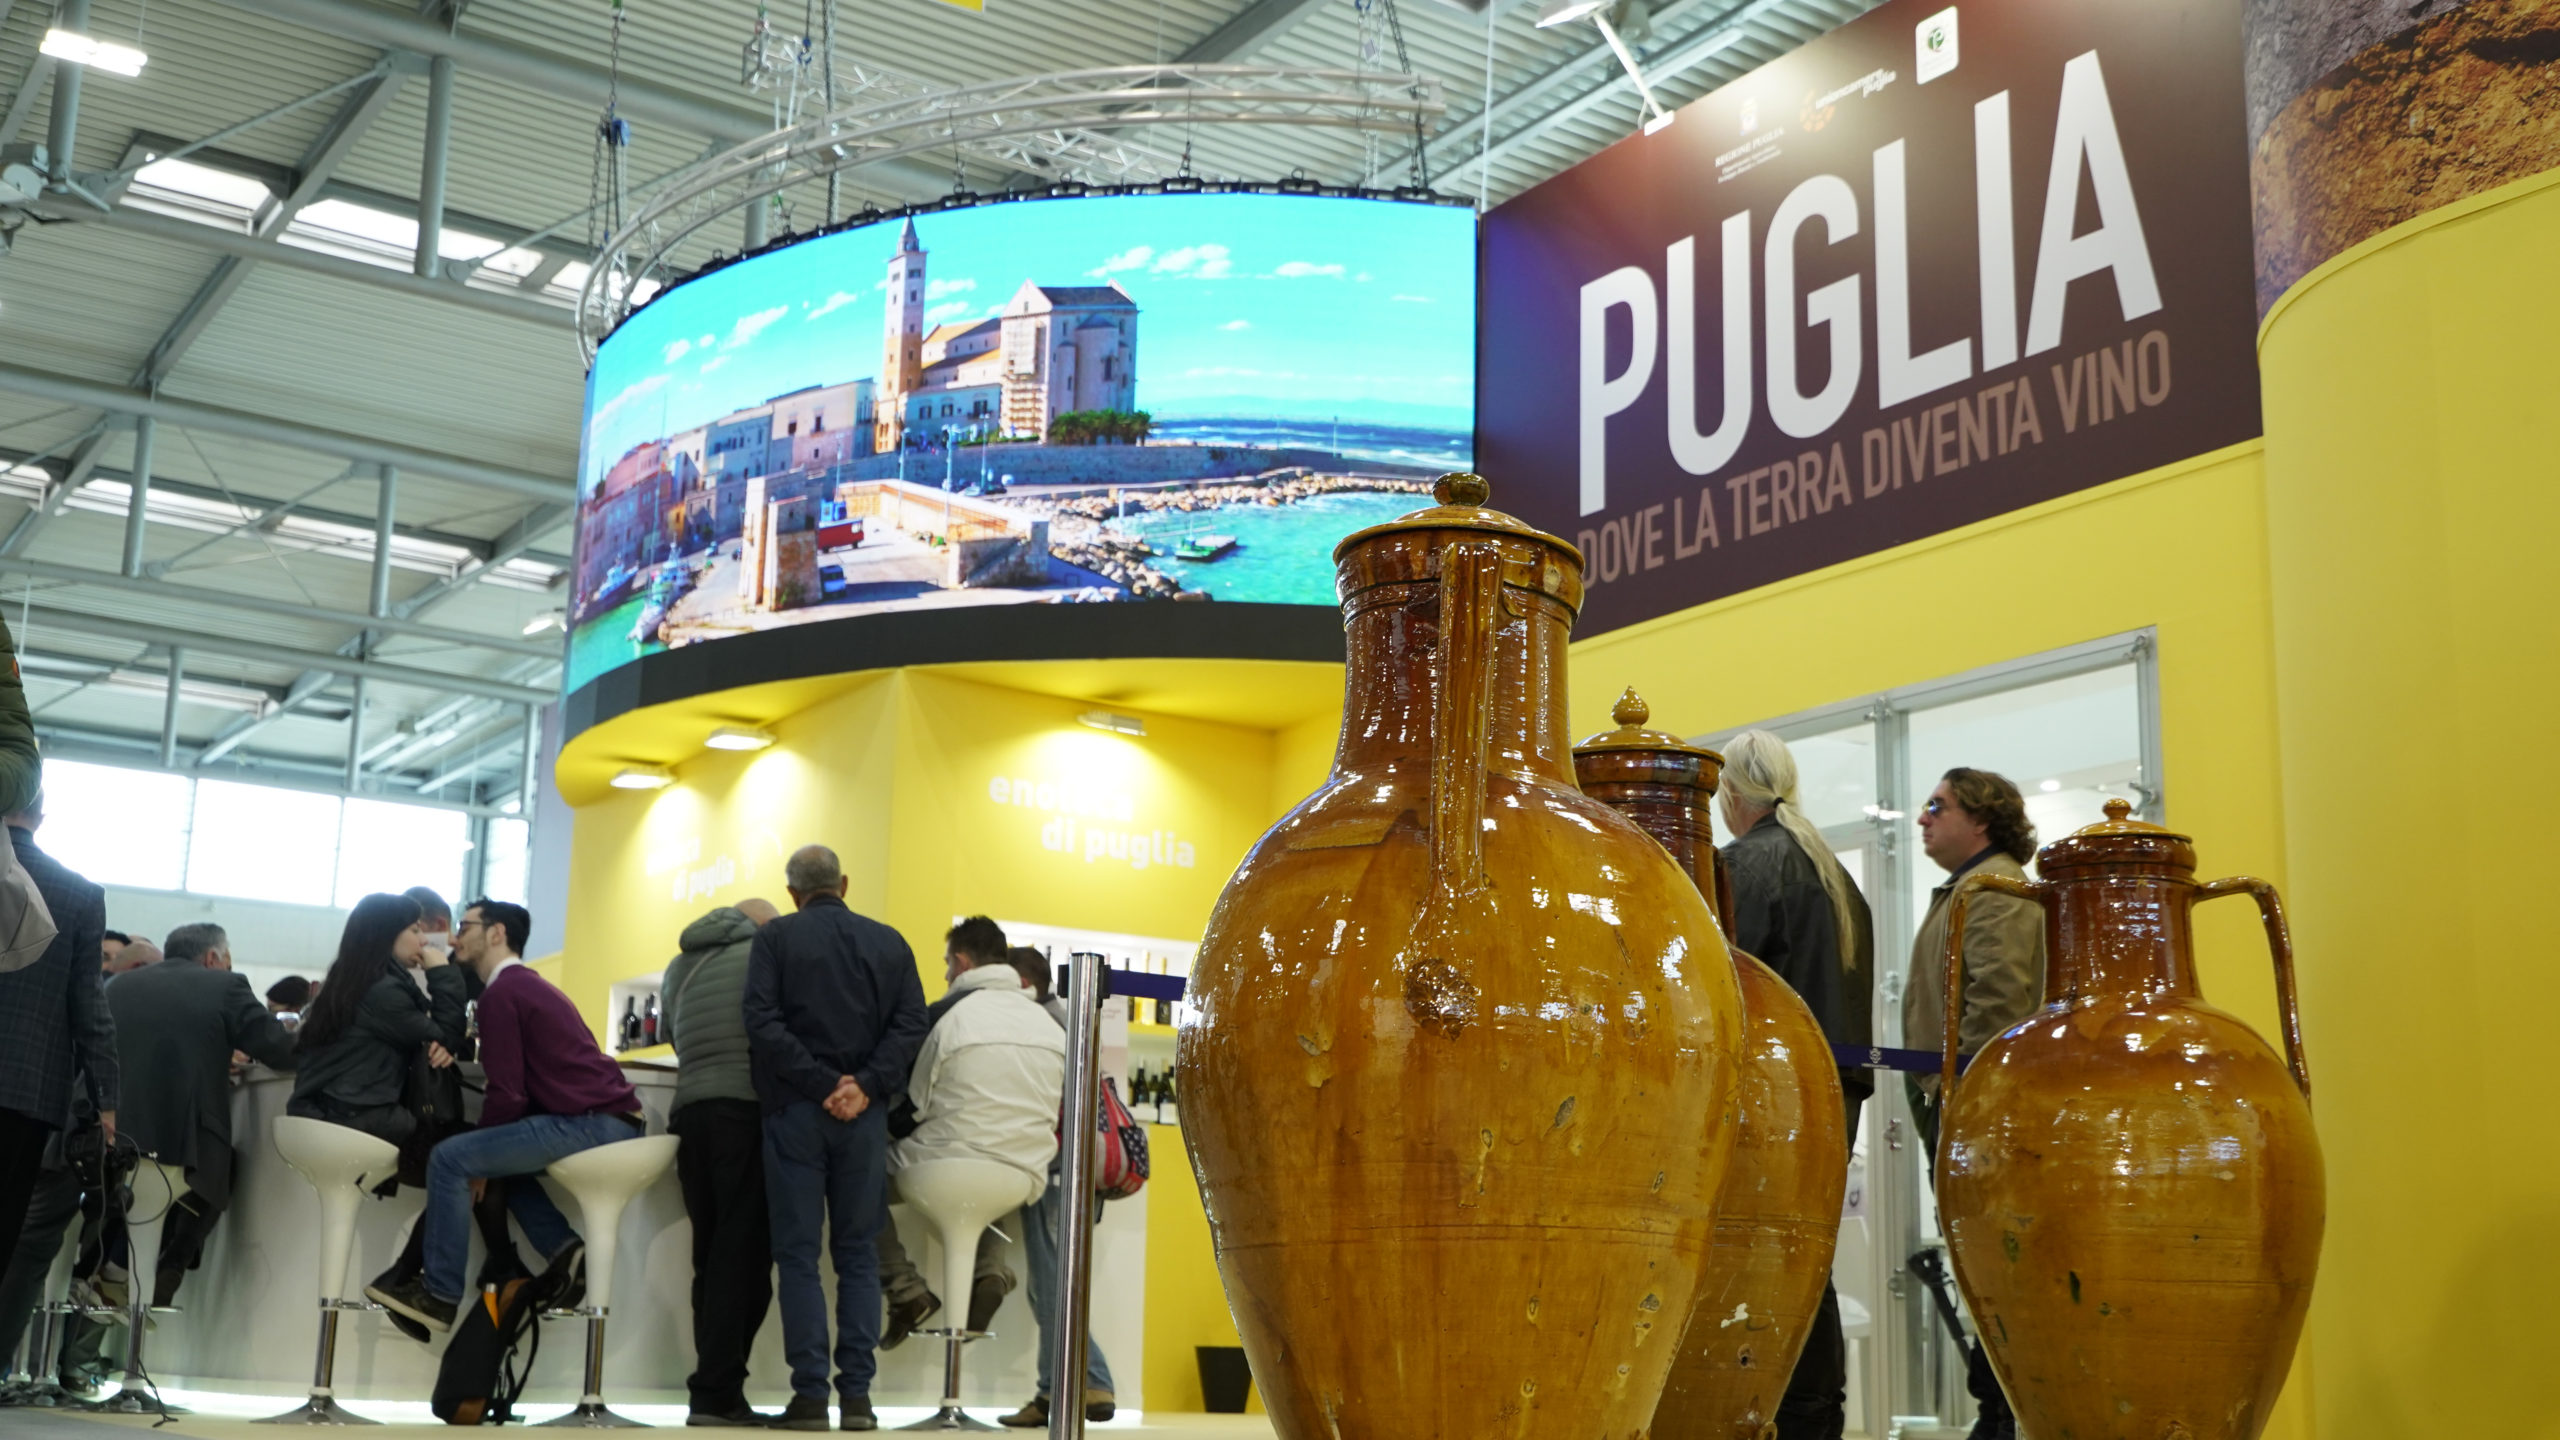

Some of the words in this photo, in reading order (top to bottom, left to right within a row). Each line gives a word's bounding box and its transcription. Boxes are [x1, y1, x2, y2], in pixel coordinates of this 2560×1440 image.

[1714, 141, 1751, 168] REGIONE
[1752, 127, 1784, 150] PUGLIA
[1580, 48, 2163, 518] PUGLIA
[1577, 503, 1664, 591] DOVE
[1674, 487, 1720, 561] LA
[1725, 441, 1853, 541] TERRA
[1862, 375, 2043, 500] DIVENTA
[2051, 329, 2171, 434] VINO
[988, 774, 1134, 823] enota
[1041, 815, 1077, 853] di
[1083, 827, 1197, 871] puglia
